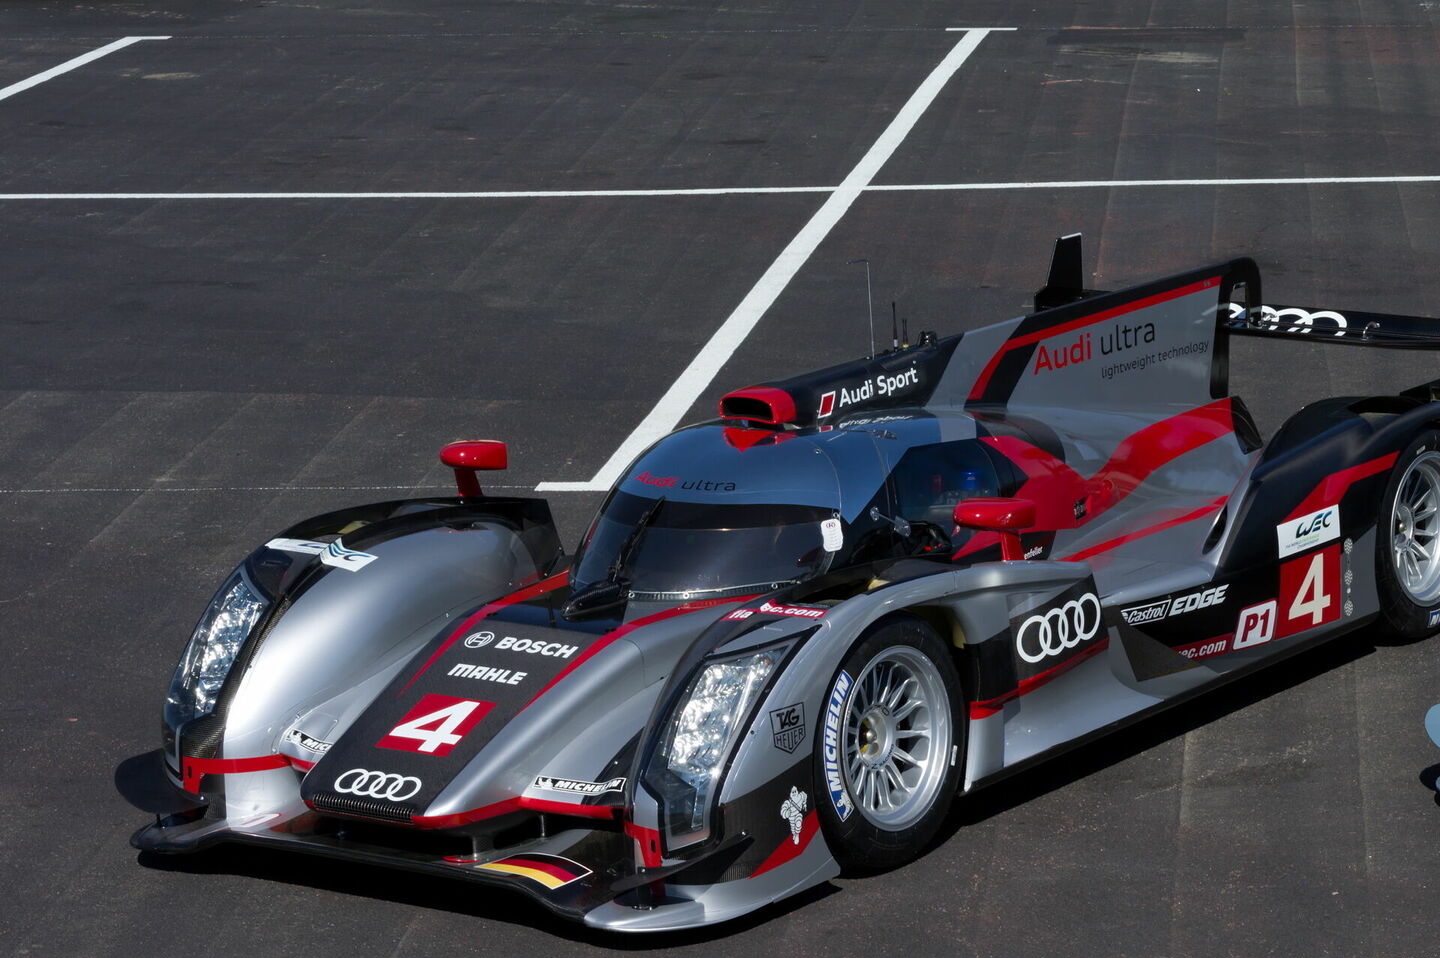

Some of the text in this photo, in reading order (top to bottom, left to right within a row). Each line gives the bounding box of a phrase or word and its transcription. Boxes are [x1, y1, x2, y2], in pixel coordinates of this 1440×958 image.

[1032, 322, 1155, 376] Audi ultra
[1101, 339, 1210, 379] lightweight technology
[839, 367, 919, 408] Audi Sport
[633, 471, 737, 492] Audi ultra
[1295, 510, 1333, 539] WEC
[1127, 583, 1230, 624] Castrol EDGE
[1287, 552, 1331, 625] 4
[1240, 607, 1271, 643] P1
[493, 636, 580, 659] BOSCH
[447, 663, 528, 686] MAHLE
[388, 700, 481, 753] 4
[776, 707, 801, 728] TAG
[824, 673, 851, 792] MICHELIN
[775, 727, 806, 751] HEUER
[554, 779, 622, 793] MICHELIN
